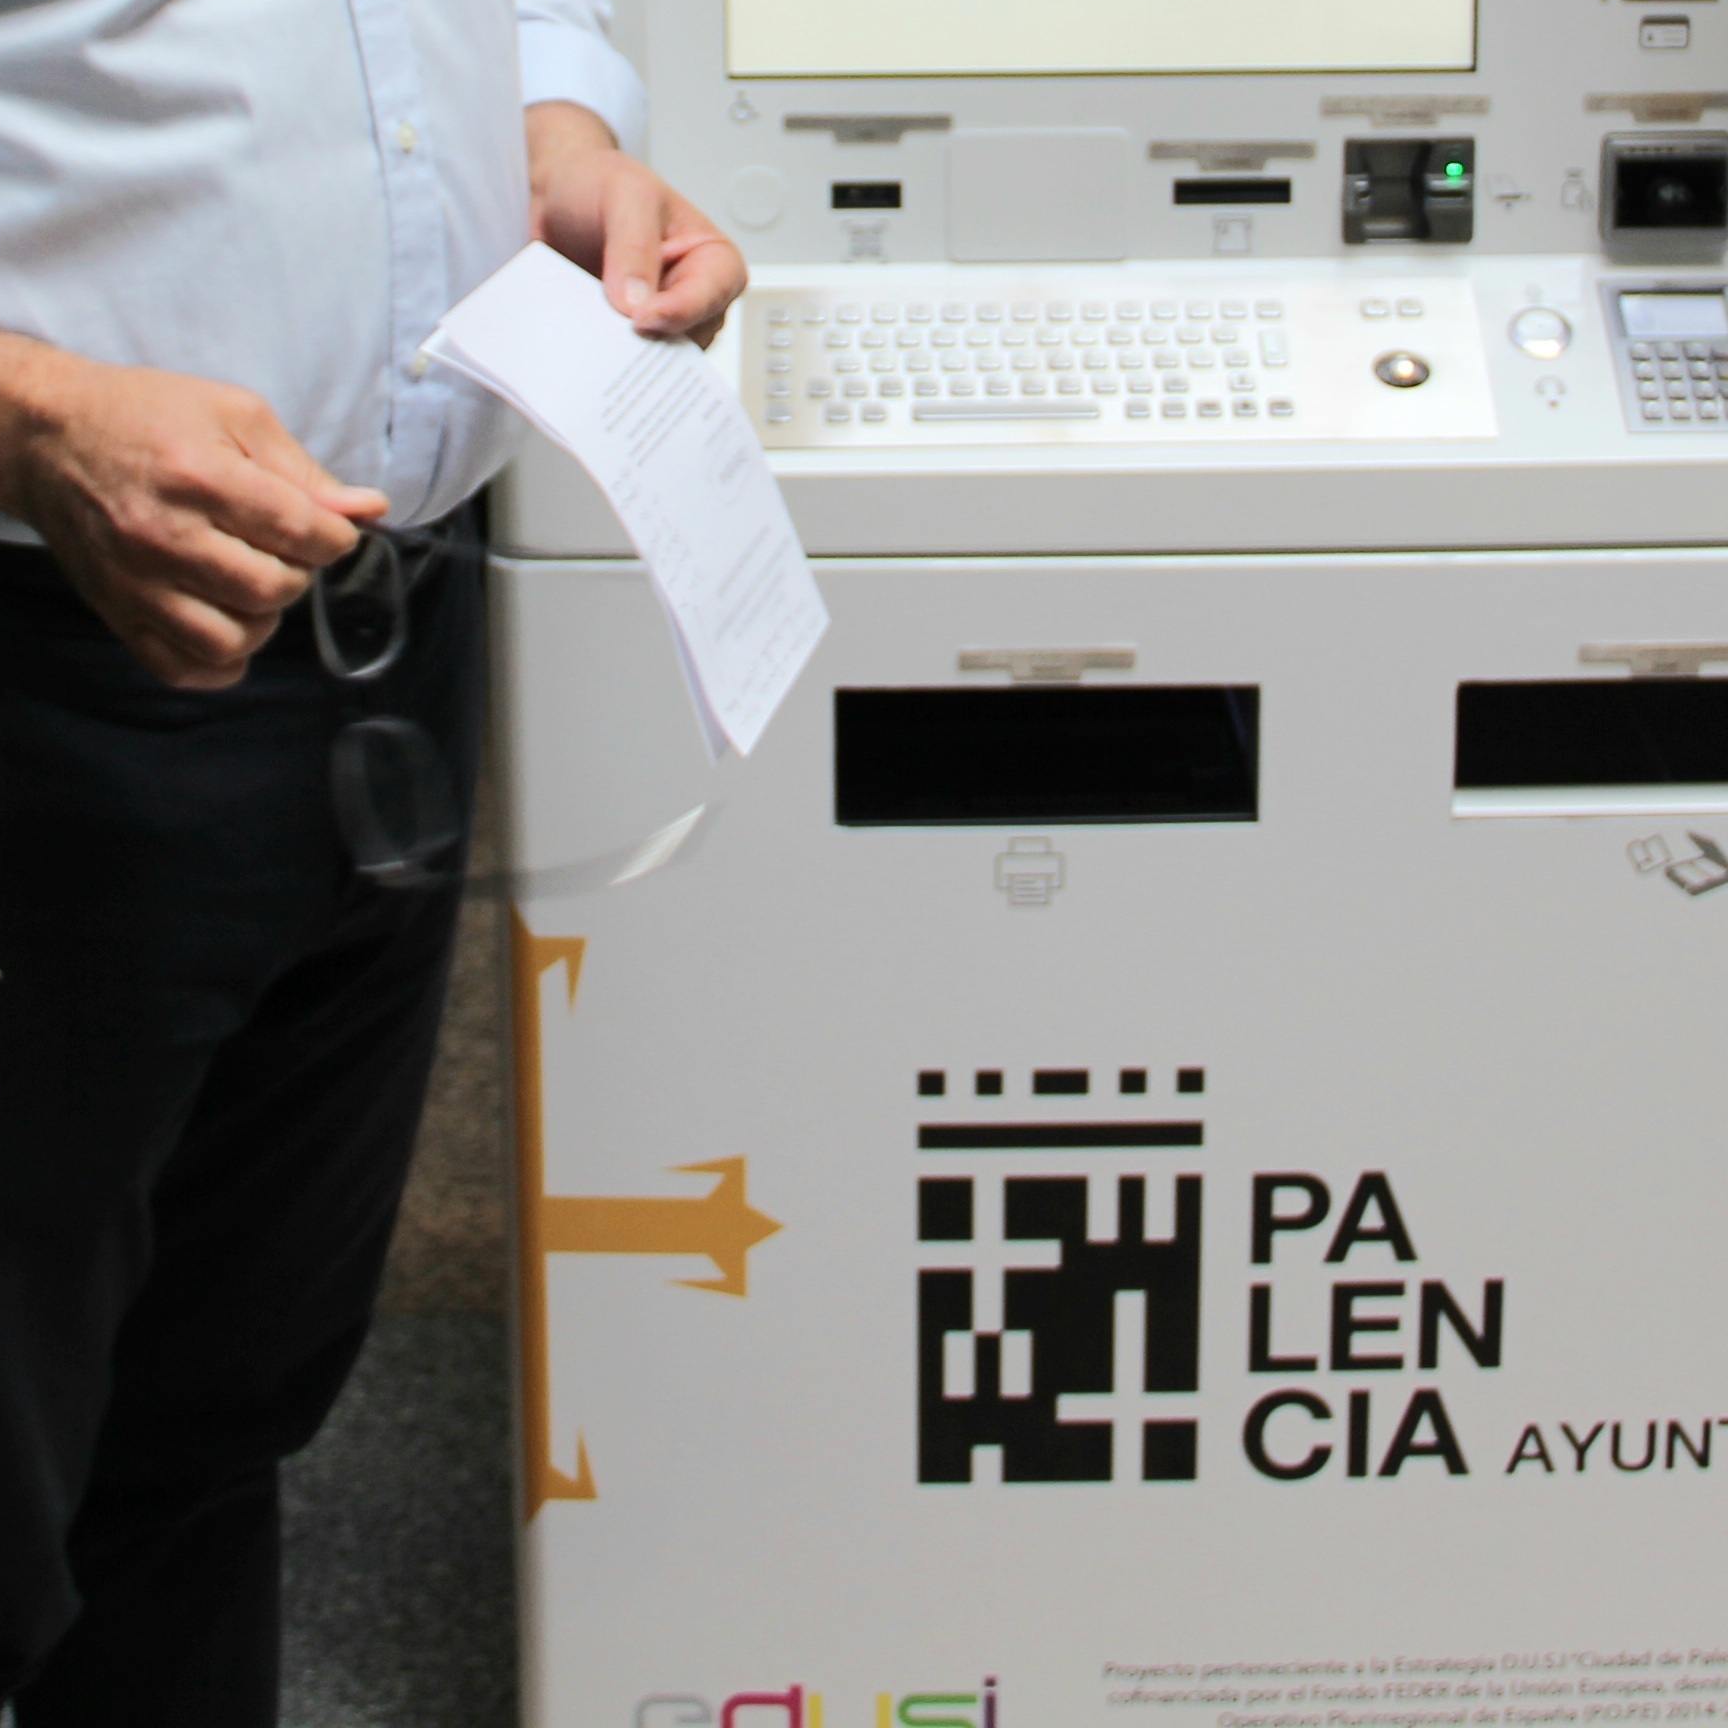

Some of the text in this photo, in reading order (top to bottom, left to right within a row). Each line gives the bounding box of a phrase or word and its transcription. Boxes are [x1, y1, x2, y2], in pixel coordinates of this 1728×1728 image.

[1249, 1170, 1419, 1266] PA
[1248, 1278, 1506, 1374] LEN
[1241, 1387, 1472, 1480] CIA
